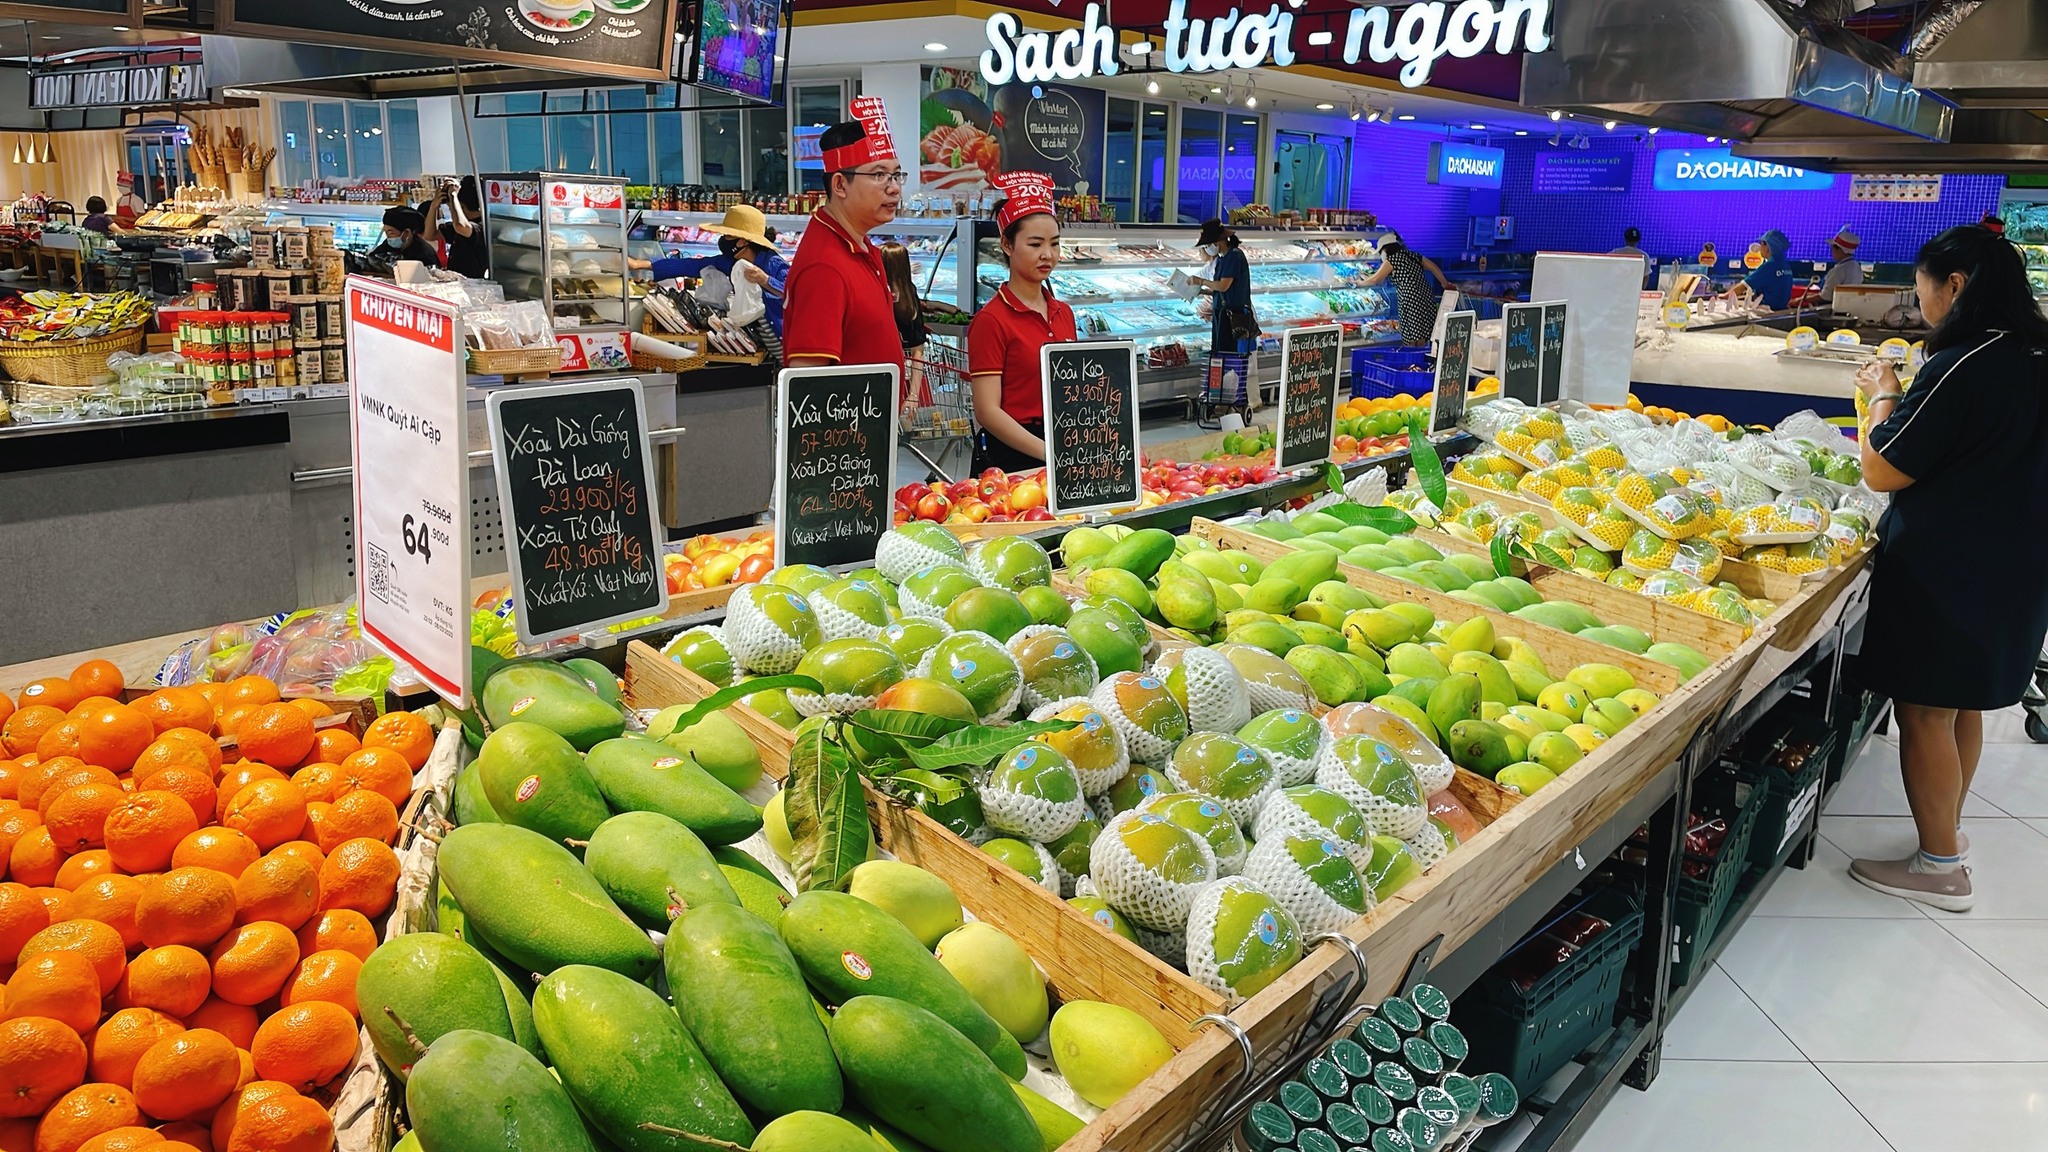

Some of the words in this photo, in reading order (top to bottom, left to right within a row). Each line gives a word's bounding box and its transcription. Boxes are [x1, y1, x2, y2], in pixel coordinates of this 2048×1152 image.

[360, 2, 369, 13] lá
[384, 12, 405, 21] xanh,
[405, 12, 414, 21] lá
[1162, 2, 1295, 74] tươi
[1342, 0, 1551, 88] ngon
[1038, 100, 1069, 115] VinMart
[1030, 123, 1047, 134] Mách
[1048, 123, 1060, 136] bạn
[1447, 156, 1496, 176] DAOHAISAN
[1676, 161, 1804, 179] DAOHAISAN
[1019, 185, 1052, 199] 20%
[416, 309, 443, 343] MẠI
[1052, 356, 1078, 382] Xoài
[1082, 357, 1104, 381] Keo
[789, 394, 822, 429] Xoài
[826, 392, 859, 431] Giống
[862, 381, 882, 419] Úc
[1053, 411, 1076, 432] Xoài
[1077, 406, 1098, 426] Cát
[361, 393, 386, 419] VMNK
[387, 405, 408, 431] Quýt
[410, 415, 420, 434] Ai
[421, 419, 442, 446] Cập
[504, 423, 552, 460] Xoài
[556, 417, 589, 450] Dài
[590, 407, 631, 458] Giống
[791, 461, 816, 479] Xoài
[817, 454, 837, 476] Đỏ
[839, 452, 871, 477] Giống
[1054, 451, 1075, 471] Xoài
[1076, 447, 1093, 465] Cát
[1116, 444, 1132, 465] Lộc
[532, 458, 568, 489] Đài
[573, 454, 612, 482] Loan
[831, 474, 854, 493] Đài
[422, 498, 452, 524] 79.900đ
[402, 513, 432, 565] 64
[519, 523, 564, 550] Xoài
[563, 515, 587, 541] Tứ
[590, 510, 625, 551] Quý
[524, 569, 570, 610] (Xuất
[594, 569, 621, 600] Việt
[622, 554, 654, 595] Nam)
[445, 605, 454, 617] KG
